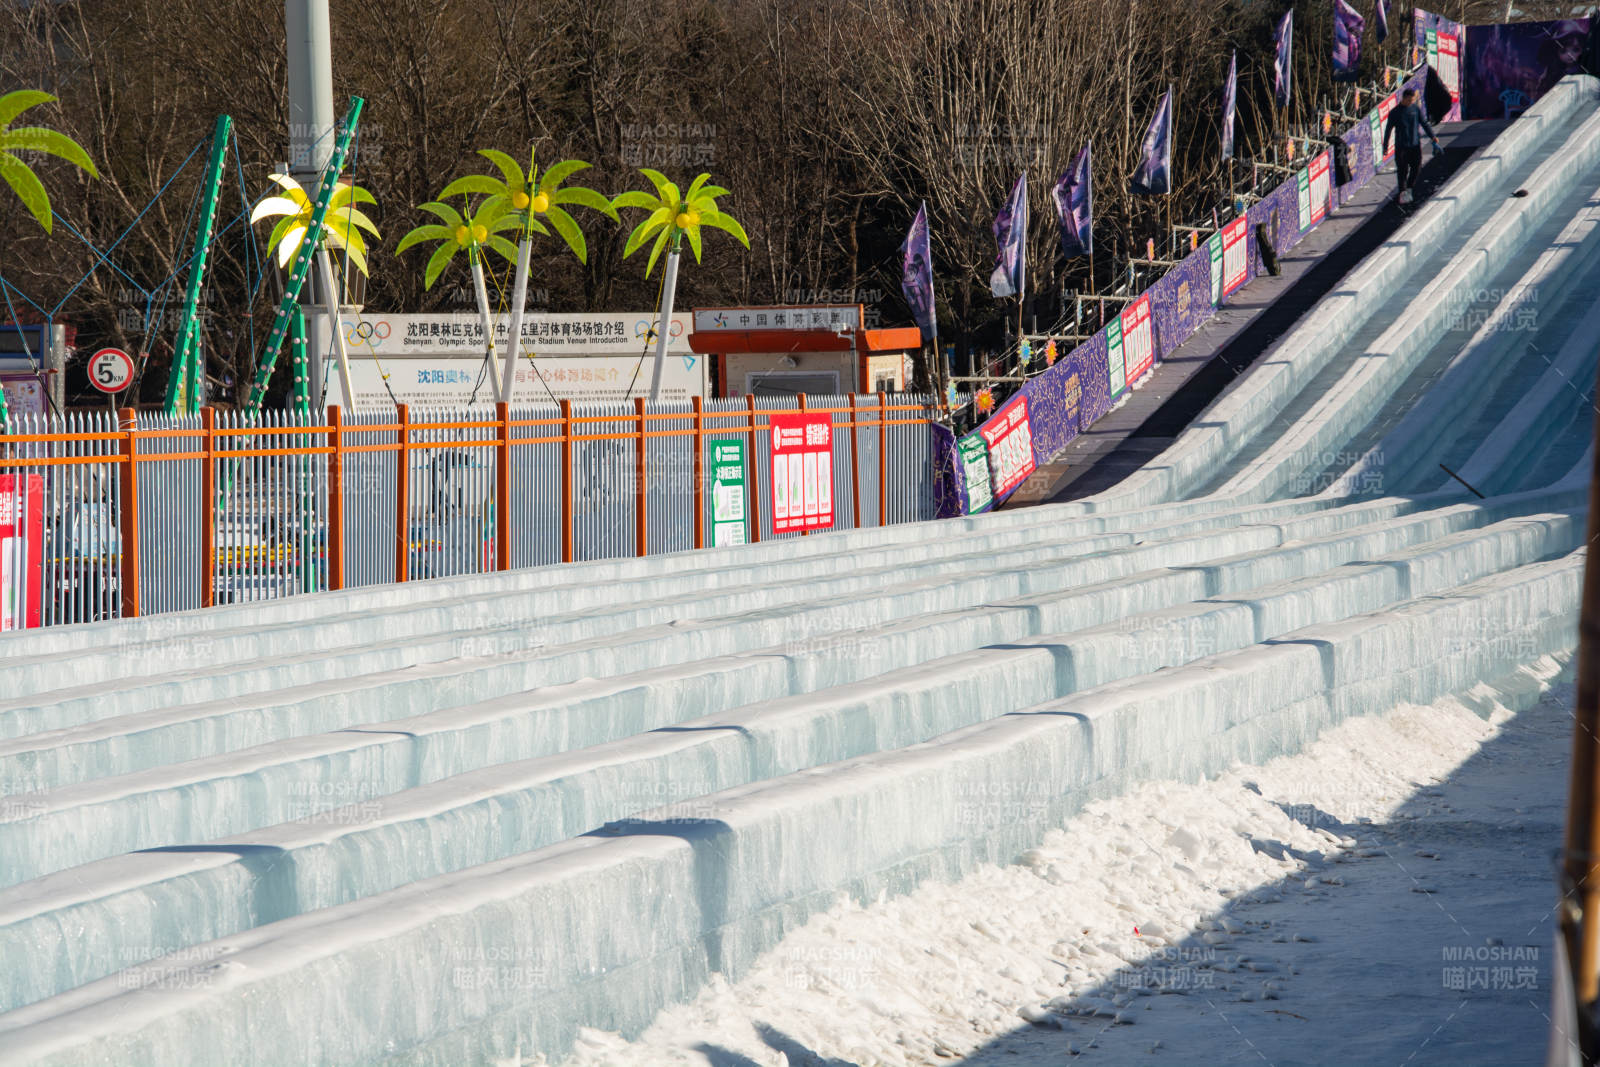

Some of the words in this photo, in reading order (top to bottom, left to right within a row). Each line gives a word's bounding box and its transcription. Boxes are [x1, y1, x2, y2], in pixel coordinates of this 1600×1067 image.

[407, 321, 625, 337] 沈阳奥林匹克体中五里河体育场场馆介绍
[403, 337, 433, 347] Shenyan
[439, 337, 466, 347] Olympic
[538, 336, 565, 345] Stadium
[567, 336, 587, 345] Venue
[589, 335, 628, 345] Introduction
